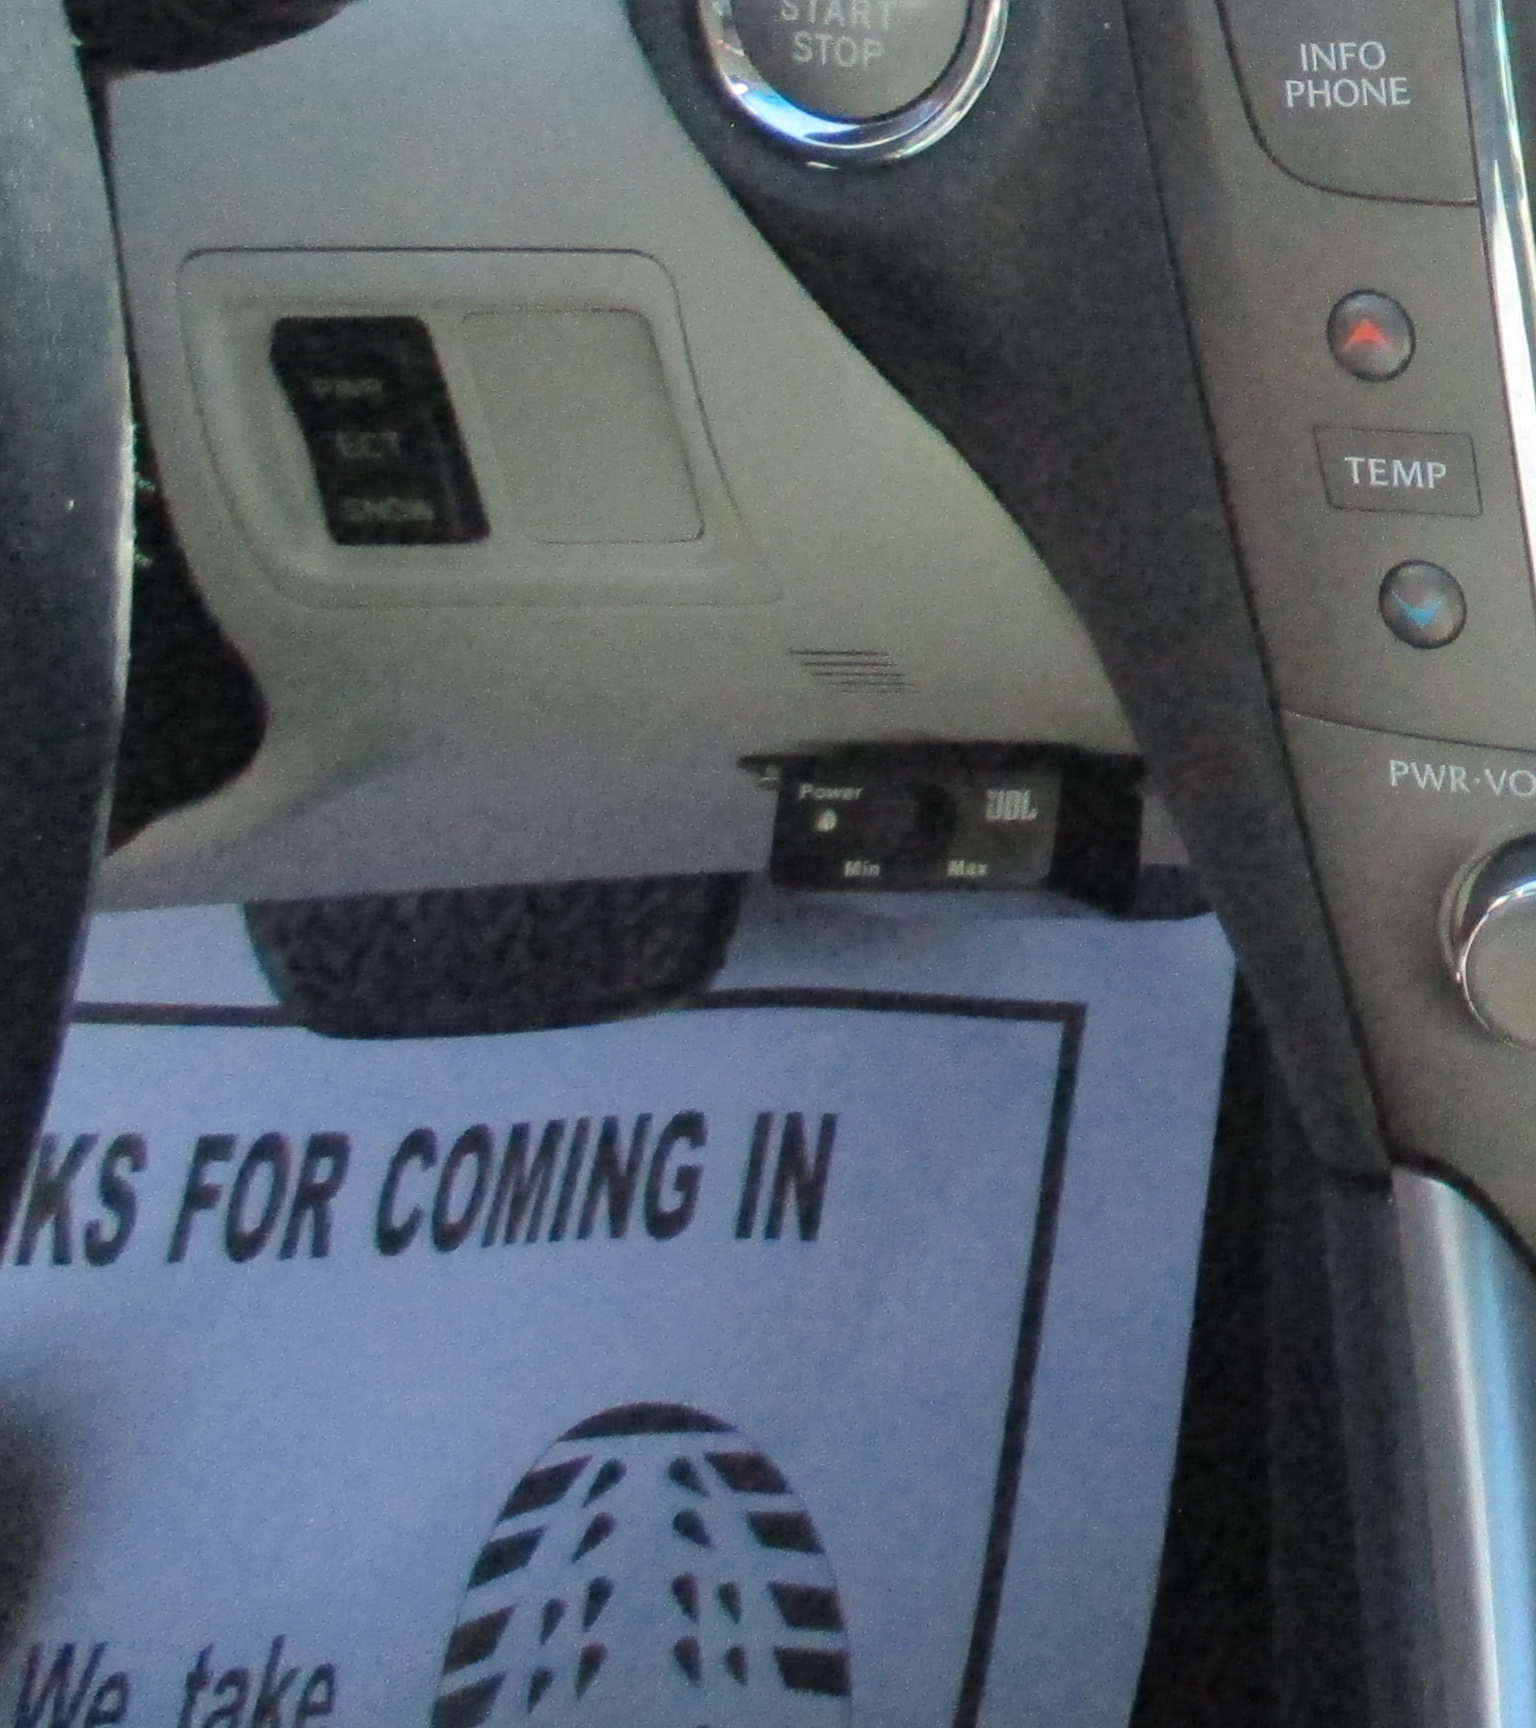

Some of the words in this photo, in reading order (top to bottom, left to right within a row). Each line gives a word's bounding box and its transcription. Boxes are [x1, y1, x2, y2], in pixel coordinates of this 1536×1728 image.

[792, 31, 885, 70] STOP
[1299, 40, 1387, 73] INFO
[1284, 76, 1411, 108] PHONE
[1343, 455, 1449, 491] TEMP
[800, 782, 864, 801] Power
[0, 1127, 150, 1268] KS
[165, 1129, 353, 1265] FOR
[375, 1109, 707, 1256] COMING
[734, 1112, 839, 1242] IN
[13, 1641, 131, 1728] We
[175, 1633, 337, 1728] take
